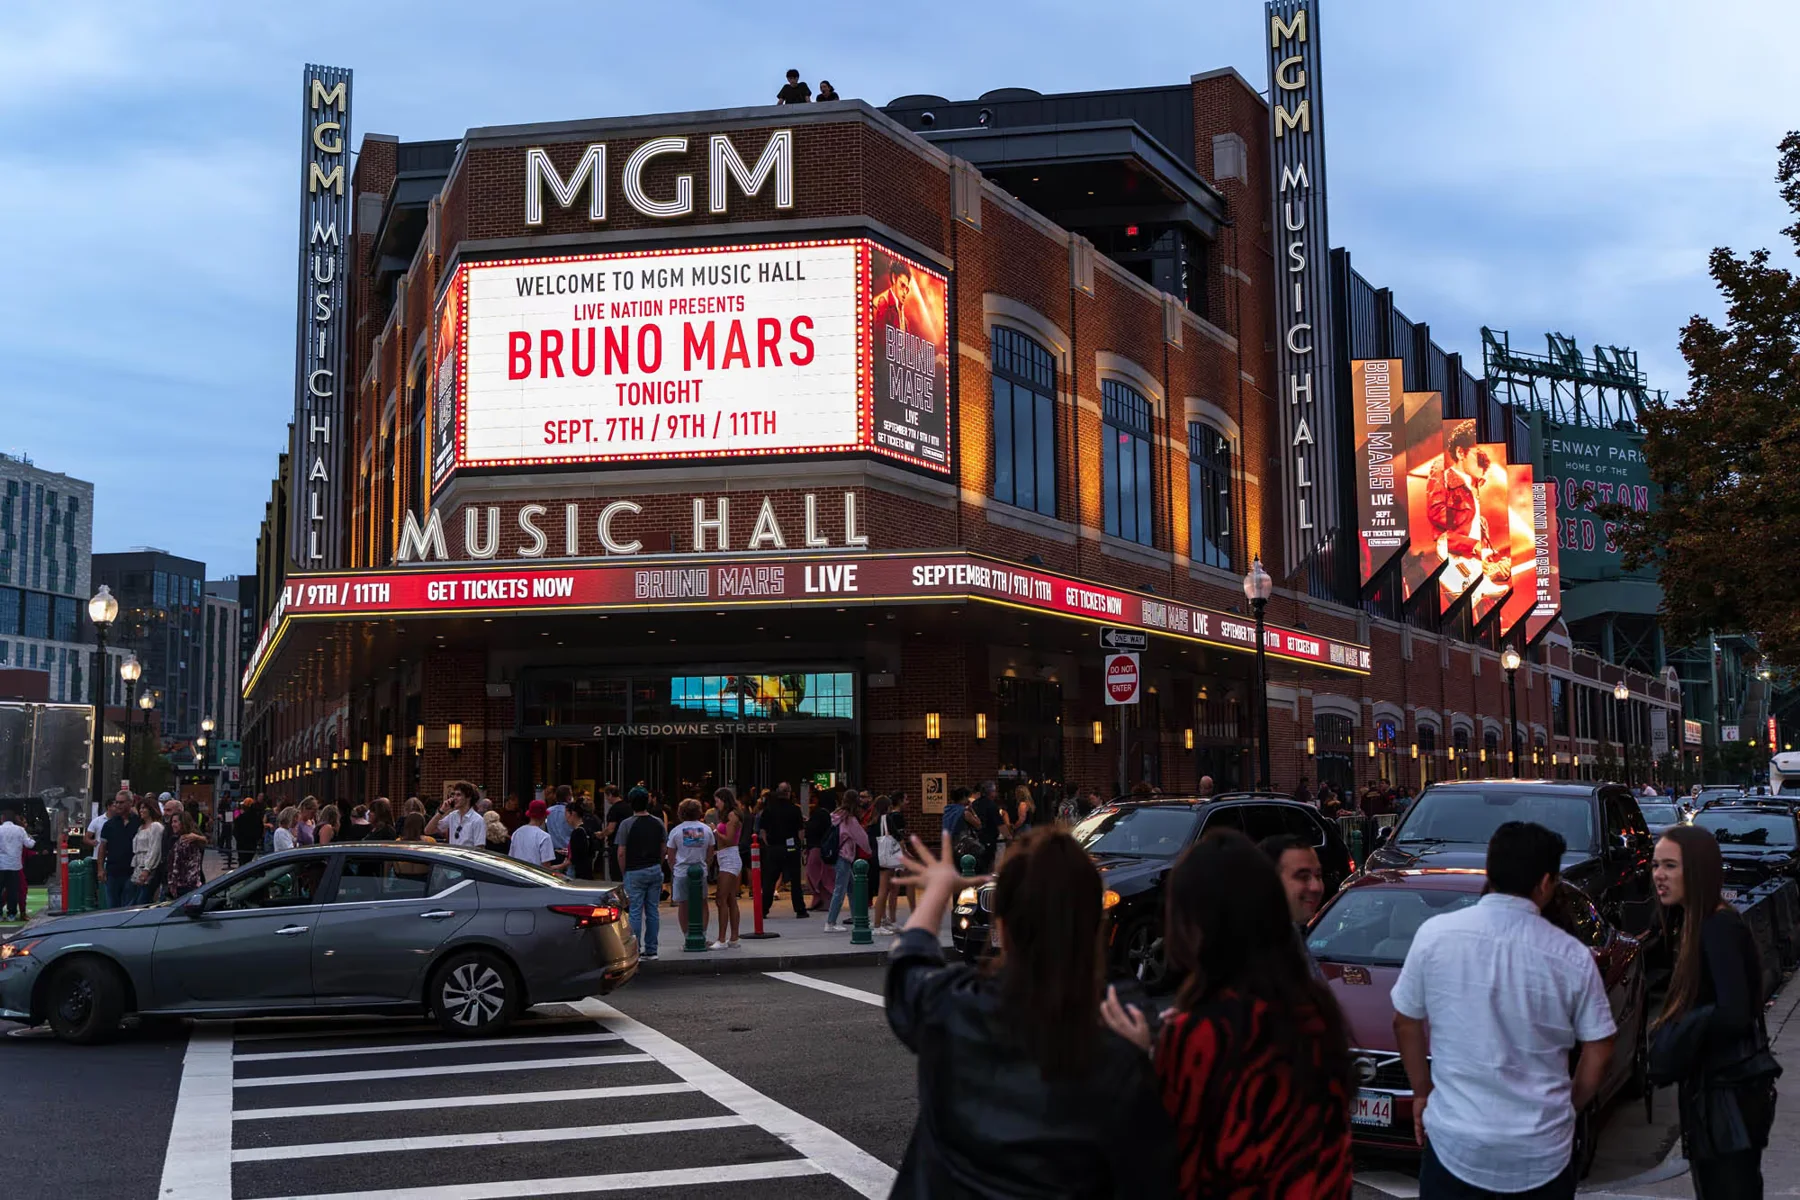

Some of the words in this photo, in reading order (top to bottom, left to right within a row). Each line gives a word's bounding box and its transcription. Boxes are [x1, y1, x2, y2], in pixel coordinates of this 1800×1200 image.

[1271, 9, 1310, 138] MGM
[309, 79, 346, 195] MGM
[526, 130, 793, 225] MGM
[1280, 162, 1312, 354] MUSIC
[516, 273, 606, 297] WELCOME
[613, 271, 634, 291] TO
[641, 268, 683, 289] MGM
[692, 264, 751, 286] MUSIC
[759, 260, 806, 282] HALL
[309, 220, 339, 397] MUSIC
[574, 303, 604, 321] LIVE
[611, 299, 663, 319] NATION
[669, 295, 745, 315] PRESENTS
[508, 323, 662, 380] BRUNO
[683, 315, 815, 371] MARS
[885, 323, 935, 378] BRUNO
[616, 379, 703, 406] TONIGHT
[889, 363, 933, 413] MARS
[1364, 360, 1392, 425] BRUNO
[543, 419, 599, 445] SEPT.
[606, 416, 644, 442] 7TH
[651, 413, 660, 442] /
[667, 413, 705, 438] 9TH
[712, 410, 722, 439] /
[729, 410, 776, 436] 11TH
[883, 419, 908, 437] SEPTEMBER
[905, 408, 919, 426] LIVE
[877, 432, 886, 443] GET
[887, 435, 904, 449] TICKETS
[904, 440, 916, 452] NOW
[1291, 373, 1314, 529] HALL
[1368, 432, 1394, 490] MARS
[1565, 461, 1591, 472] HOME
[1595, 465, 1607, 473] OF
[1611, 467, 1628, 476] THE
[309, 415, 330, 559] HALL
[1371, 493, 1394, 506] LIVE
[397, 499, 642, 561] MUSIC
[693, 491, 869, 551] HALL
[1375, 510, 1391, 518] SEPT
[294, 584, 304, 607] /
[308, 584, 337, 605] 9TH
[341, 583, 350, 606] /
[354, 583, 390, 604] 11TH
[427, 581, 457, 601] GET
[462, 579, 529, 600] TICKETS
[533, 577, 574, 597] NOW
[635, 568, 709, 599] BRUNO
[717, 566, 785, 596] MARS
[804, 565, 858, 592] LIVE
[912, 564, 991, 588] SEPTEMBER
[992, 570, 1007, 592] 7TH
[1008, 572, 1013, 594] /
[1014, 575, 1028, 596] 9TH
[1029, 577, 1034, 598] /
[1035, 580, 1052, 601] 11TH
[1066, 587, 1078, 606] GET
[1079, 589, 1106, 612] TICKETS
[1106, 596, 1122, 615] NOW
[1192, 612, 1209, 635] LIVE
[1221, 621, 1247, 641] SEPTEMBER
[1359, 650, 1370, 669] LIVE
[1115, 634, 1127, 642] ONE
[1110, 666, 1119, 674] DO
[1121, 665, 1133, 673] NOT
[1112, 684, 1132, 692] ENTER
[593, 726, 601, 736] 2
[607, 724, 709, 736] LANSDOWNE
[715, 722, 777, 734] STREET
[1372, 1101, 1389, 1119] 44
